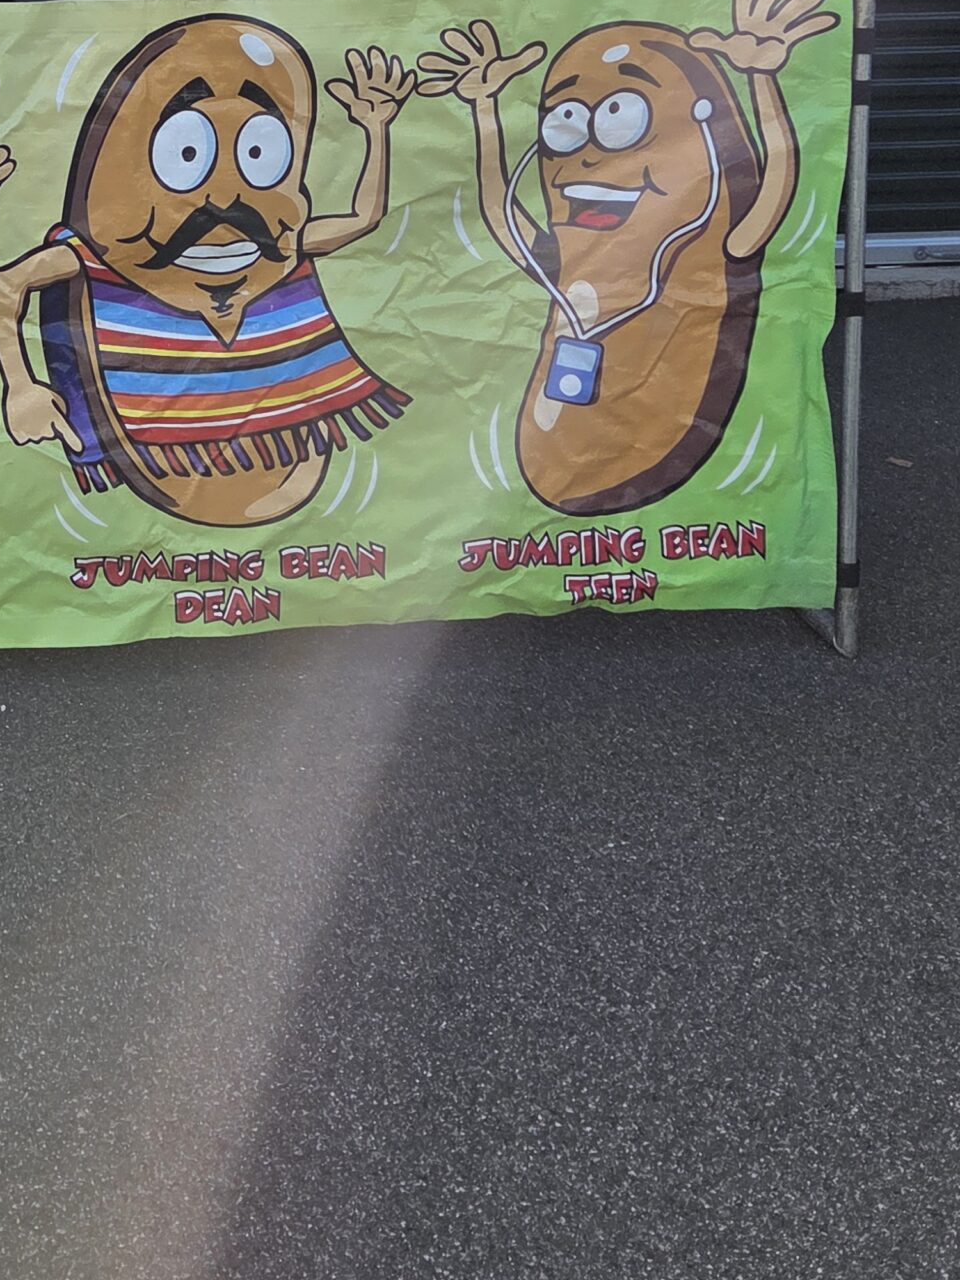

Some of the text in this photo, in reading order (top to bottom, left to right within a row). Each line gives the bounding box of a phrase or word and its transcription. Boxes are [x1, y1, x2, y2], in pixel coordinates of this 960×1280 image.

[70, 541, 386, 590] JUMPING BEAN
[458, 519, 766, 572] JUMPING BEAN
[174, 586, 281, 626] DEAN
[563, 568, 659, 605] TEEN
